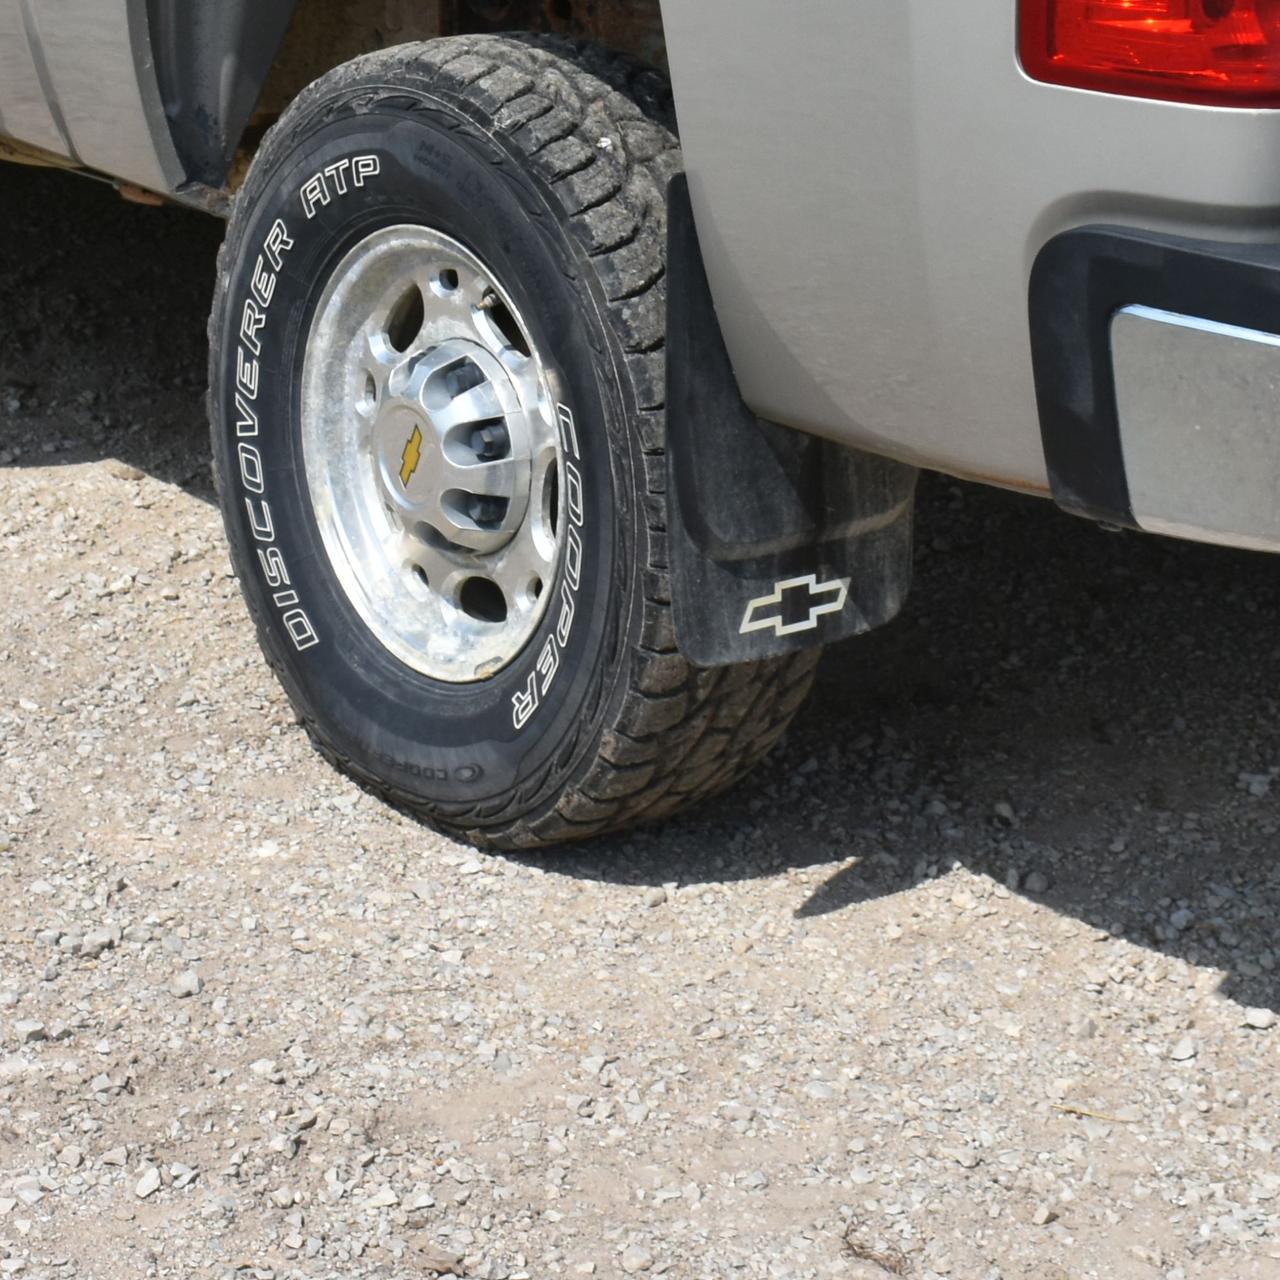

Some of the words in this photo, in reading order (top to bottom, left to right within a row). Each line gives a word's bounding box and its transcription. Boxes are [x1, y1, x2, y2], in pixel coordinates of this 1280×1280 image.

[300, 154, 381, 219] ATP
[235, 219, 320, 651] DISCOVERER
[511, 402, 583, 730] COOPER
